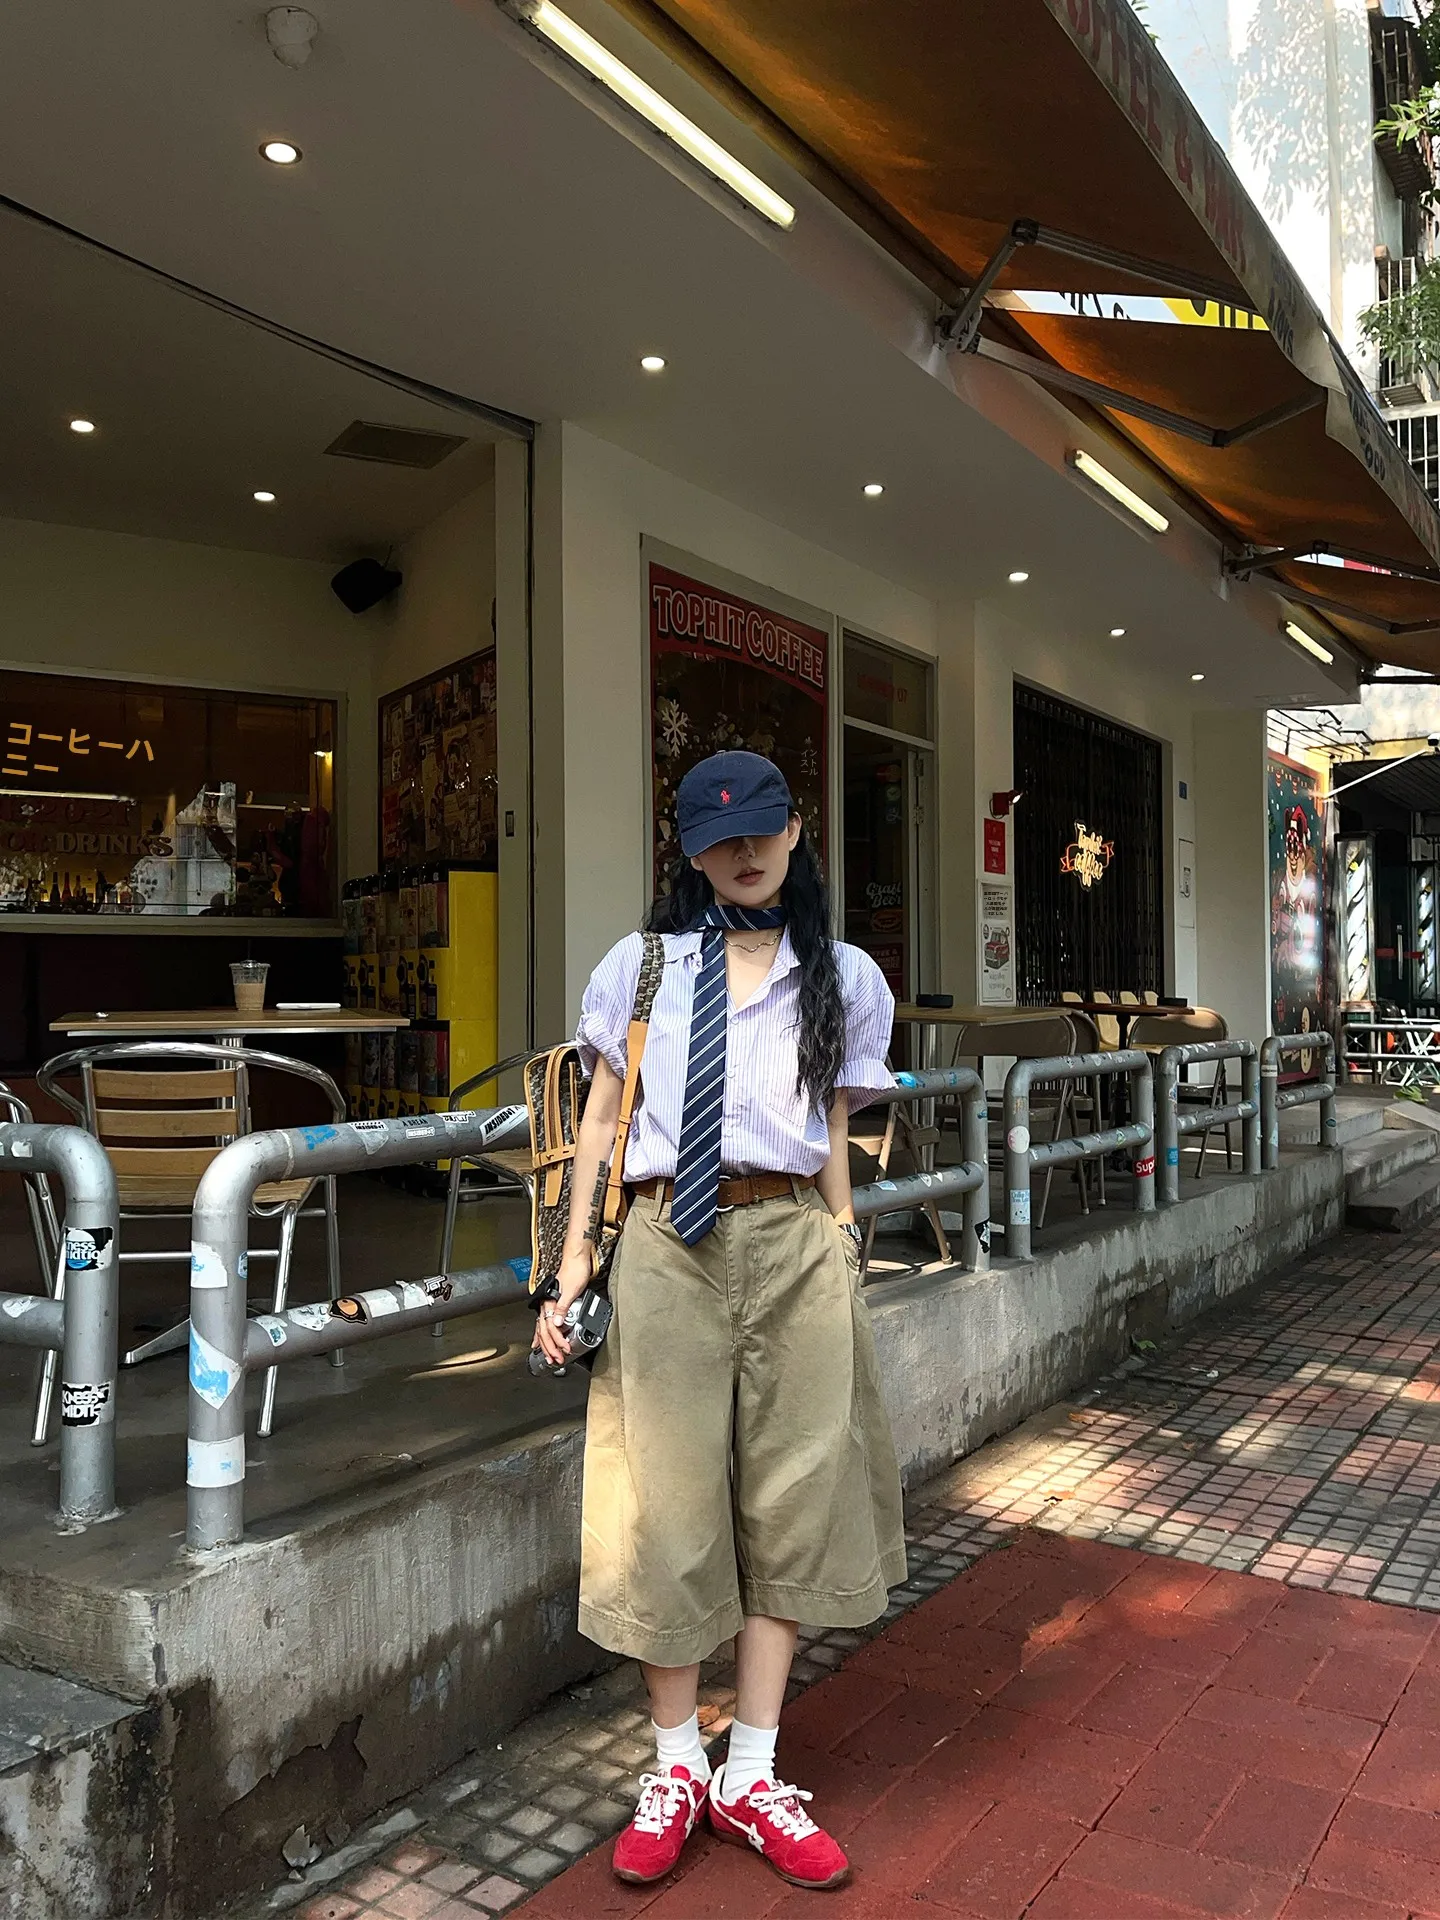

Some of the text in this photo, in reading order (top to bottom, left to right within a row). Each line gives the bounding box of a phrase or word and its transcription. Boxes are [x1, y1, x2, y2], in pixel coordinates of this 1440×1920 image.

[652, 584, 825, 688] TOPHIT COFFEE
[7, 721, 155, 762] コーヒーハ
[55, 831, 174, 857] DRINKS
[597, 1160, 607, 1178] you
[590, 1179, 604, 1209] future
[587, 1209, 598, 1224] the
